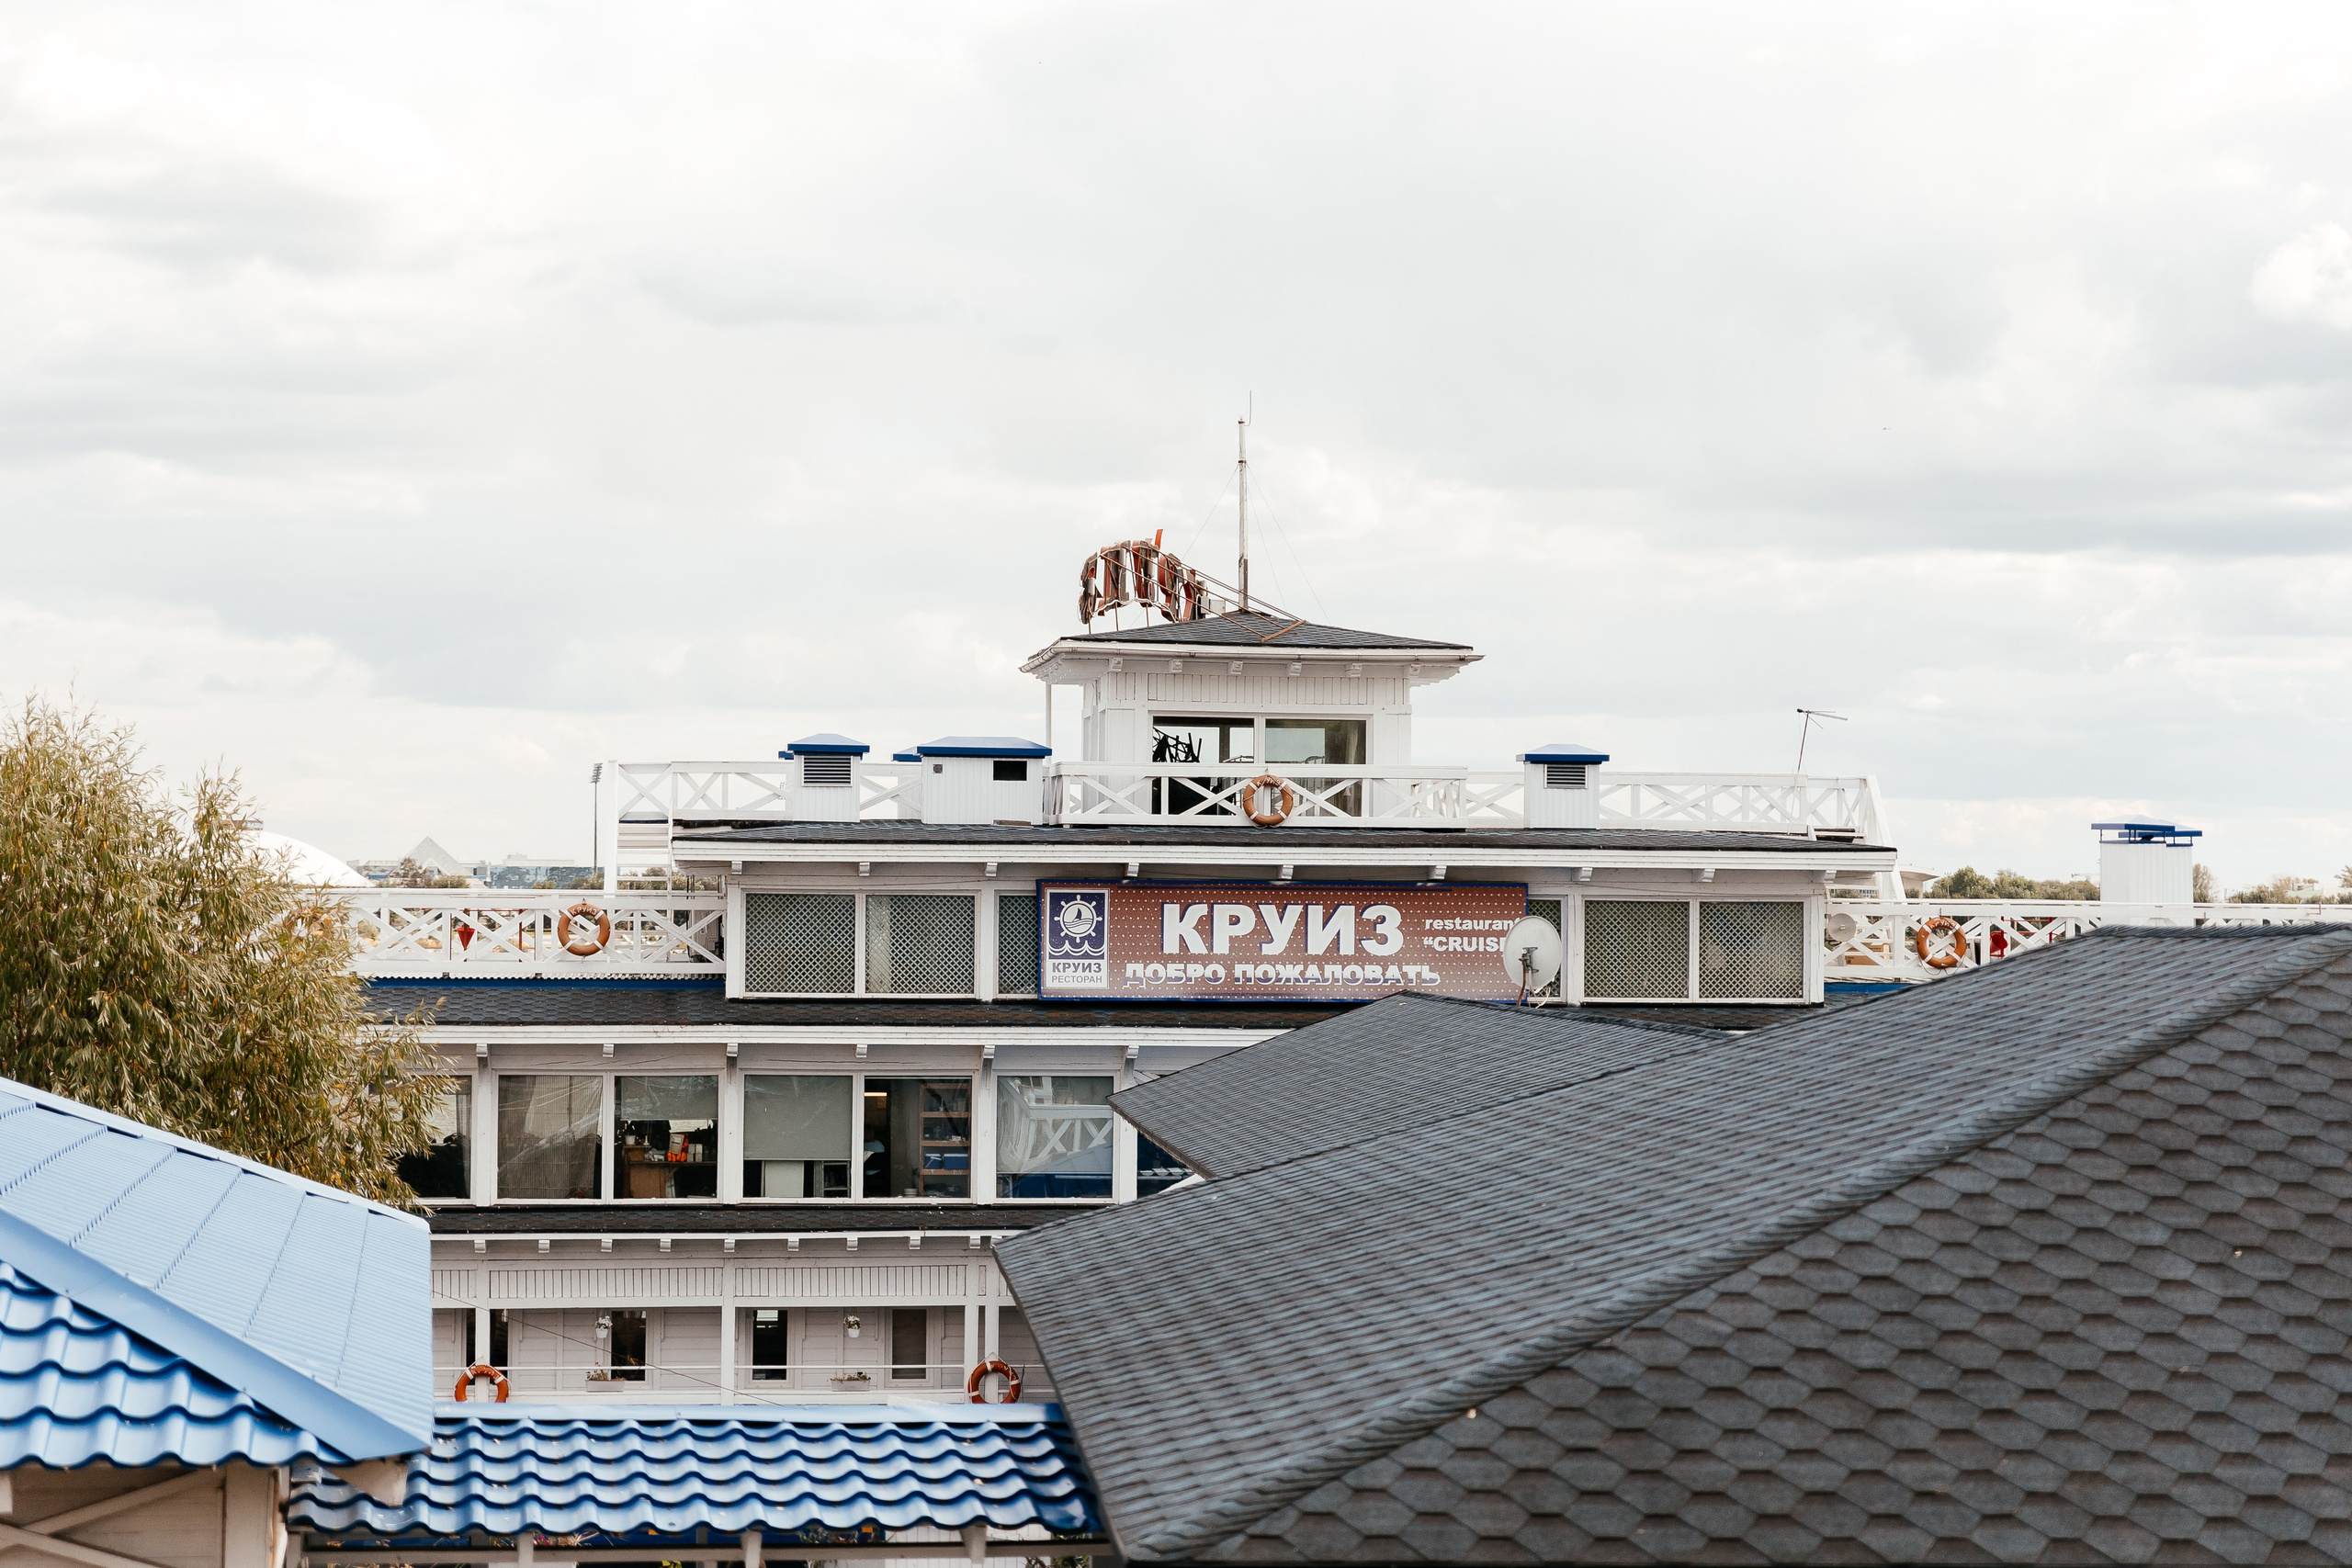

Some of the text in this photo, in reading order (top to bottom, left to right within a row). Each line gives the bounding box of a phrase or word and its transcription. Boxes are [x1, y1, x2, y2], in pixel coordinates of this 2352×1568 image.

[571, 906, 598, 916] КРУИЗ
[1161, 903, 1404, 955] КРУИЗ
[1052, 962, 1102, 974] КРУИЗ
[1051, 976, 1102, 984] РЕСТОРАН
[1123, 964, 1441, 988] ДОБРО ПОЖАЛОВАТЬ
